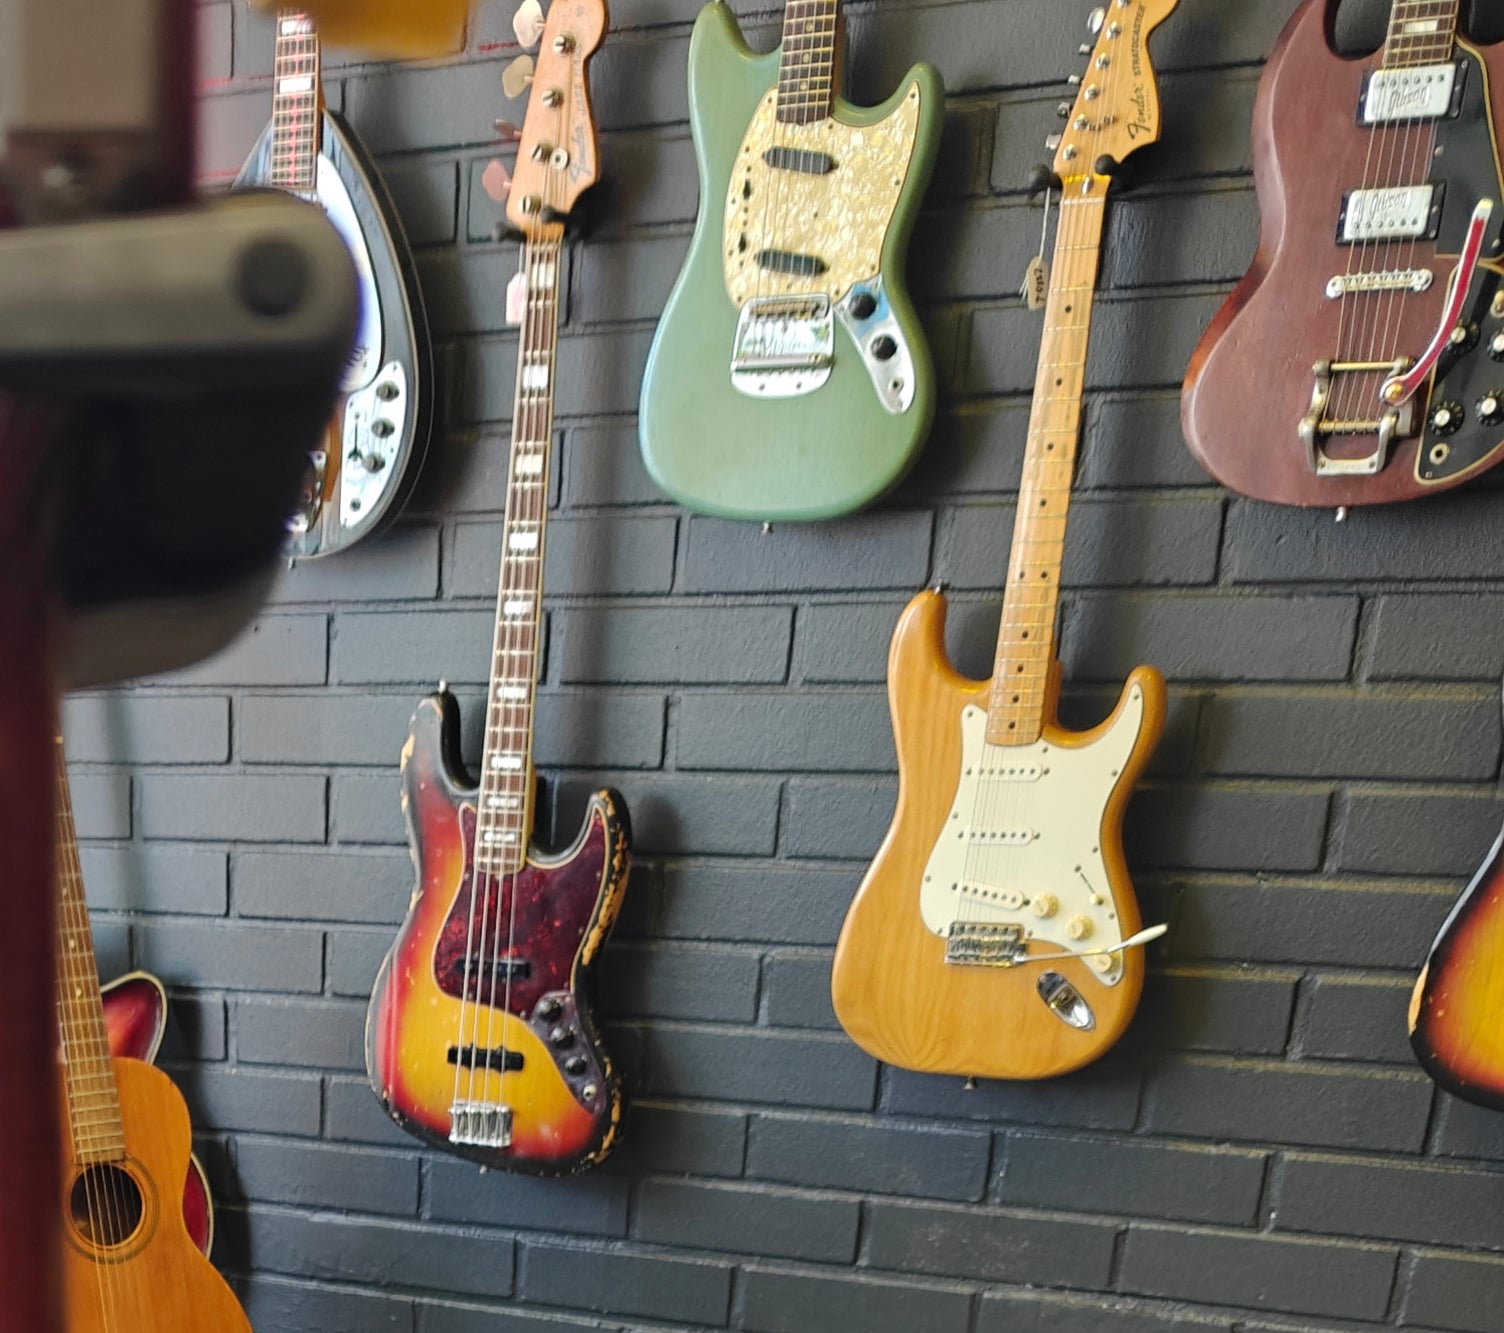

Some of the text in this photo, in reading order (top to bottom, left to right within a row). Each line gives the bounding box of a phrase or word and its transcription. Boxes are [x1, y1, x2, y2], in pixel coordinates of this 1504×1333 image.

[1127, 5, 1151, 140] Fender STRATOCASTER
[1370, 191, 1408, 219] Gibson
